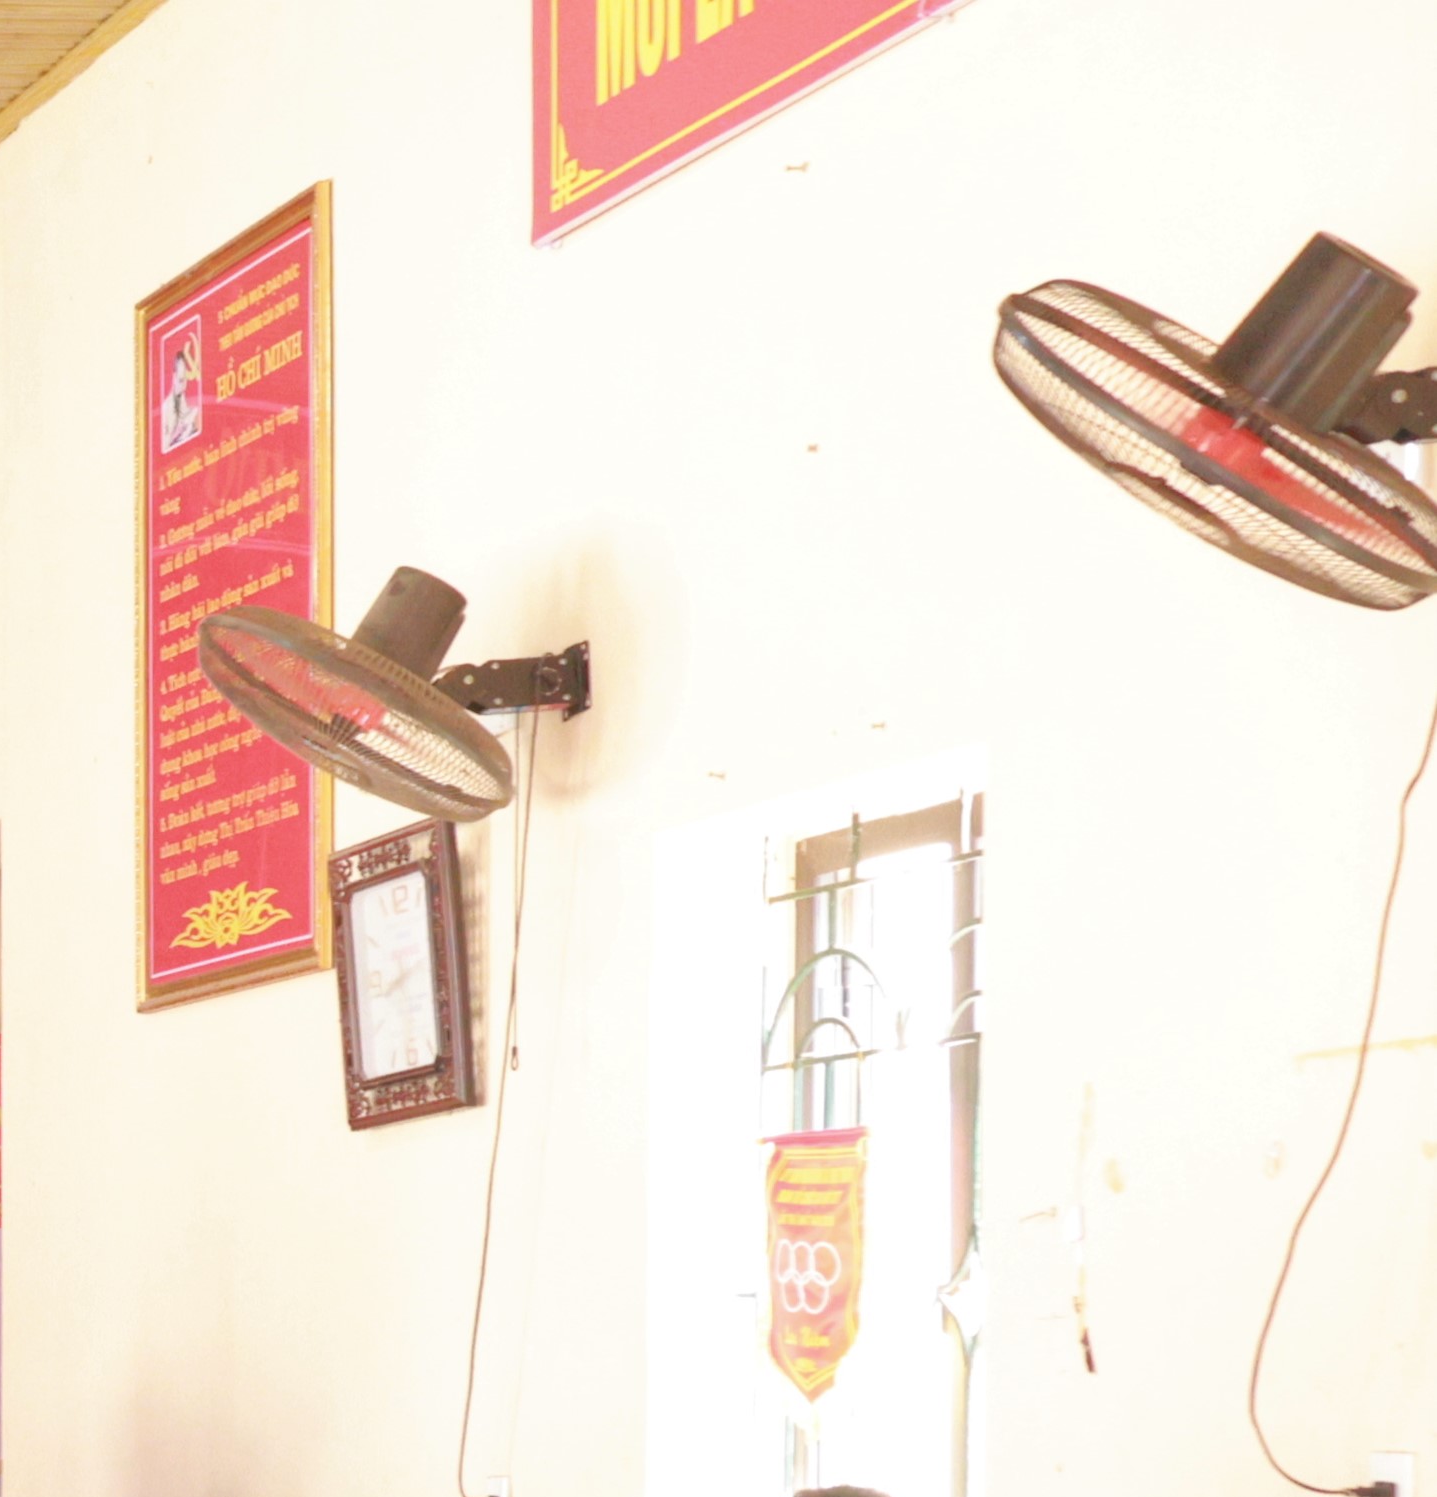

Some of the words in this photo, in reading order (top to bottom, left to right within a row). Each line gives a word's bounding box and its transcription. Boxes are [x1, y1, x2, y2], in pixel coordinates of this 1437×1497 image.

[215, 357, 237, 403] HỒ
[237, 346, 262, 389] CHÍ
[263, 330, 303, 376] MINH
